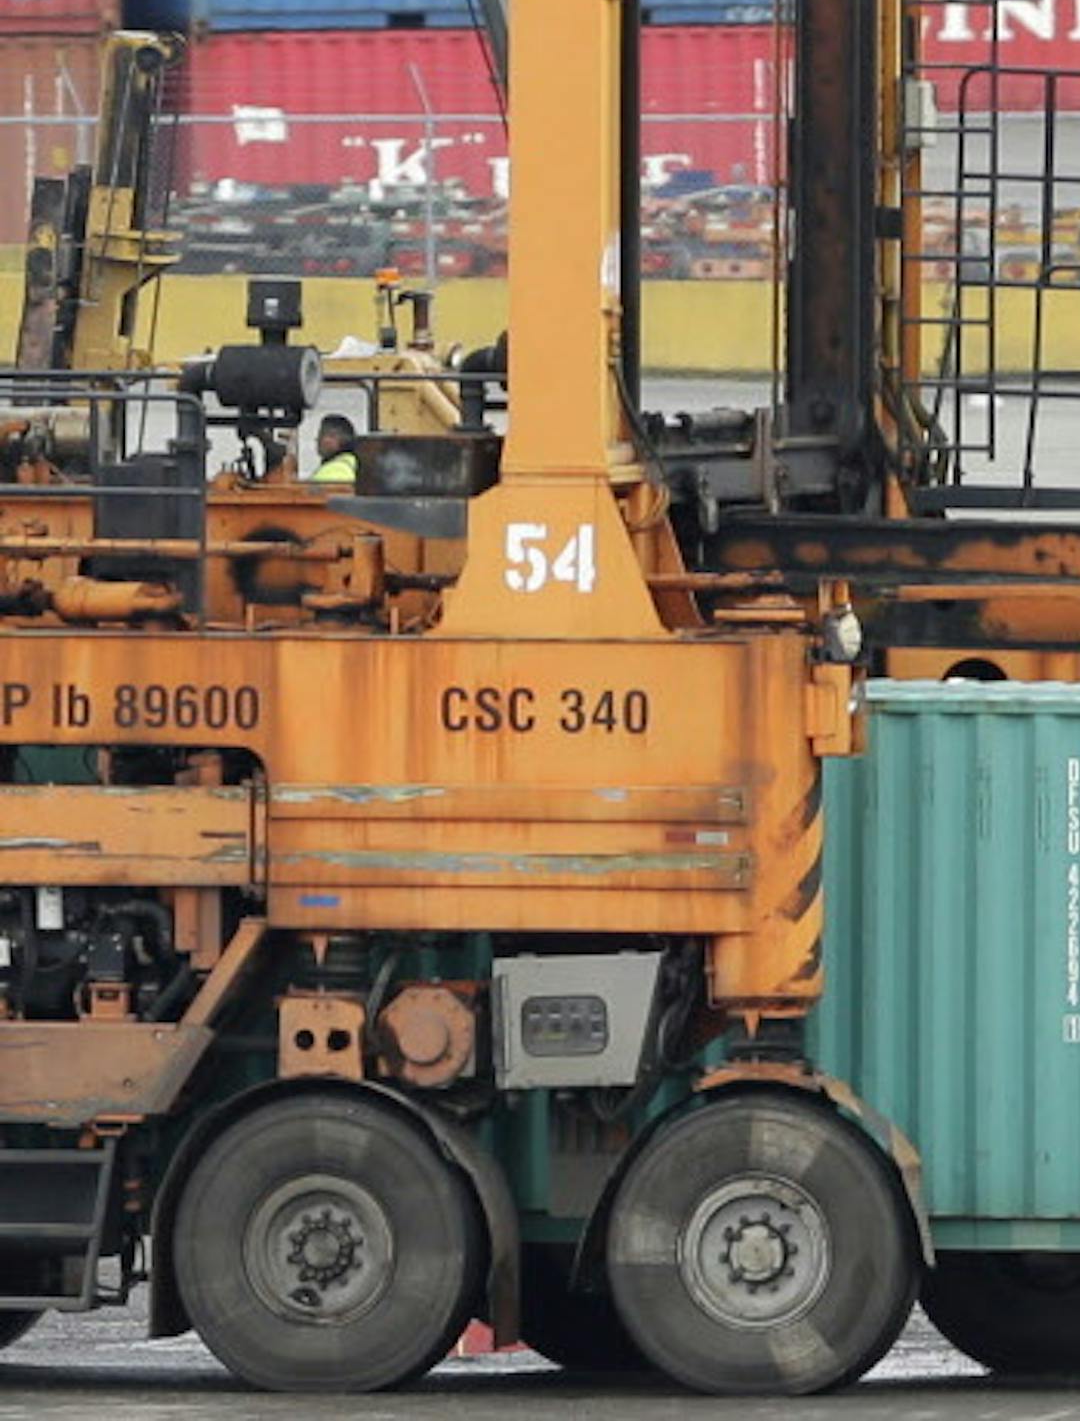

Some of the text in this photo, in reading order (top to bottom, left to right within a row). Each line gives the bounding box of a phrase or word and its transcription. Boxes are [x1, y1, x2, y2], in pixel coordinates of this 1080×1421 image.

[505, 522, 597, 594] 54
[52, 683, 91, 728] lb
[113, 683, 261, 730] 89600
[441, 687, 649, 734] CSC 340
